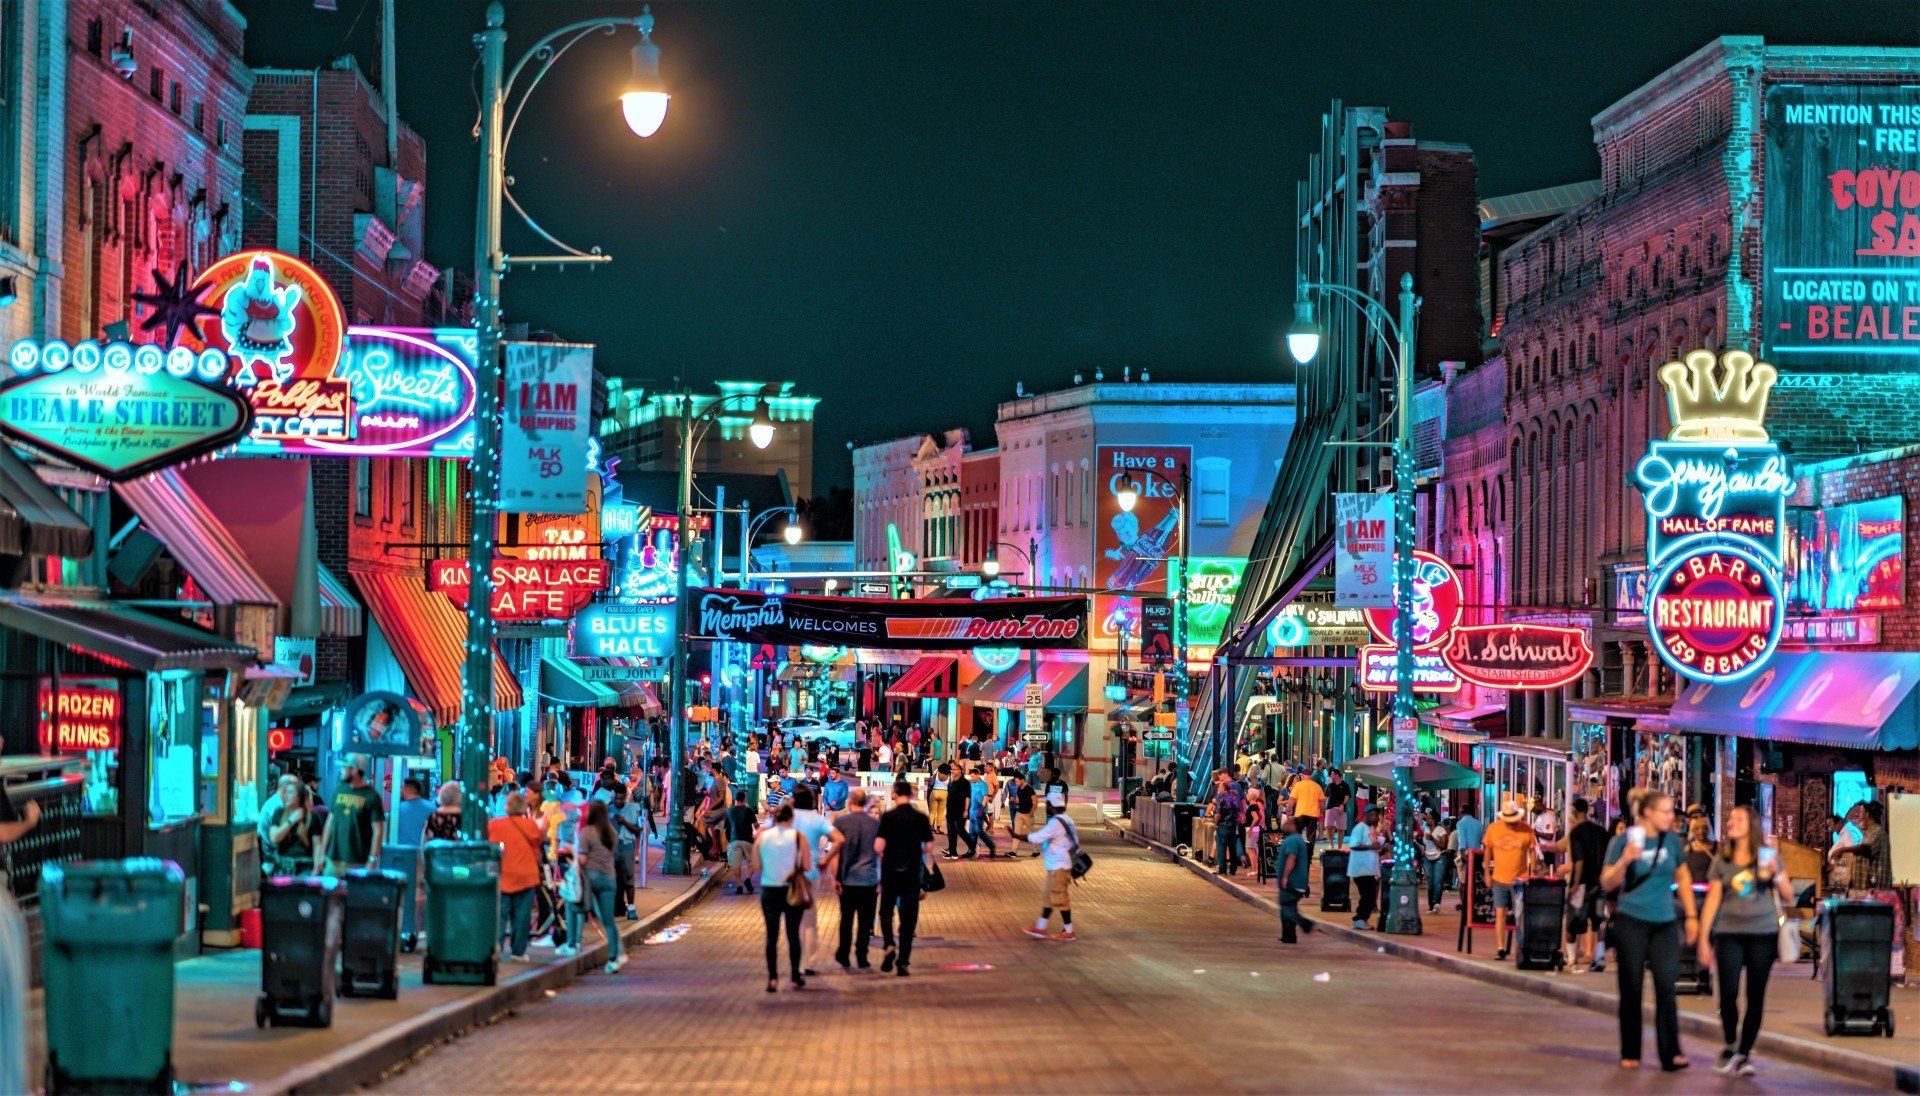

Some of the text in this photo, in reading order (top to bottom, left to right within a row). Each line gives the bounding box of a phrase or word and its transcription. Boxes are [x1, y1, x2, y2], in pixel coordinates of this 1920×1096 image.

[1786, 105, 1872, 125] MENTION
[1875, 129, 1920, 152] FRE
[1782, 280, 1866, 301] LOCATED
[1872, 281, 1899, 301] ON
[282, 266, 324, 313] CHICKEN
[315, 312, 333, 367] GREASE
[1808, 305, 1920, 340] BEALE
[361, 350, 457, 410] Sweets
[66, 383, 169, 398] to World Famous
[520, 381, 578, 412] I AM
[11, 398, 227, 428] BEALE STREET
[519, 415, 577, 432] MEMPHIS
[528, 447, 562, 462] MLK
[1113, 451, 1176, 469] Have a
[540, 461, 563, 479] 50
[1346, 520, 1385, 539] I AM
[1662, 518, 1775, 534] HALL OF FAME
[544, 528, 586, 545] TAP
[1346, 542, 1386, 554] MEMPHIS
[1353, 563, 1376, 574] MLK
[1689, 552, 1745, 582] BAR
[1361, 573, 1378, 586] 50
[491, 590, 565, 614] AFE
[700, 606, 785, 638] Memphis
[788, 617, 878, 633] WELCOMES
[963, 614, 1080, 639] AutoZone
[1656, 597, 1774, 629] RESTAURANT
[592, 616, 668, 634] BLUES
[599, 636, 660, 655] HALL
[1450, 632, 1585, 662] A. Schwab
[1665, 633, 1767, 675] 159 BEALE
[588, 668, 659, 679] JUKE JOINT
[1474, 667, 1541, 679] ESTABLISHED
[1026, 695, 1042, 705] 25
